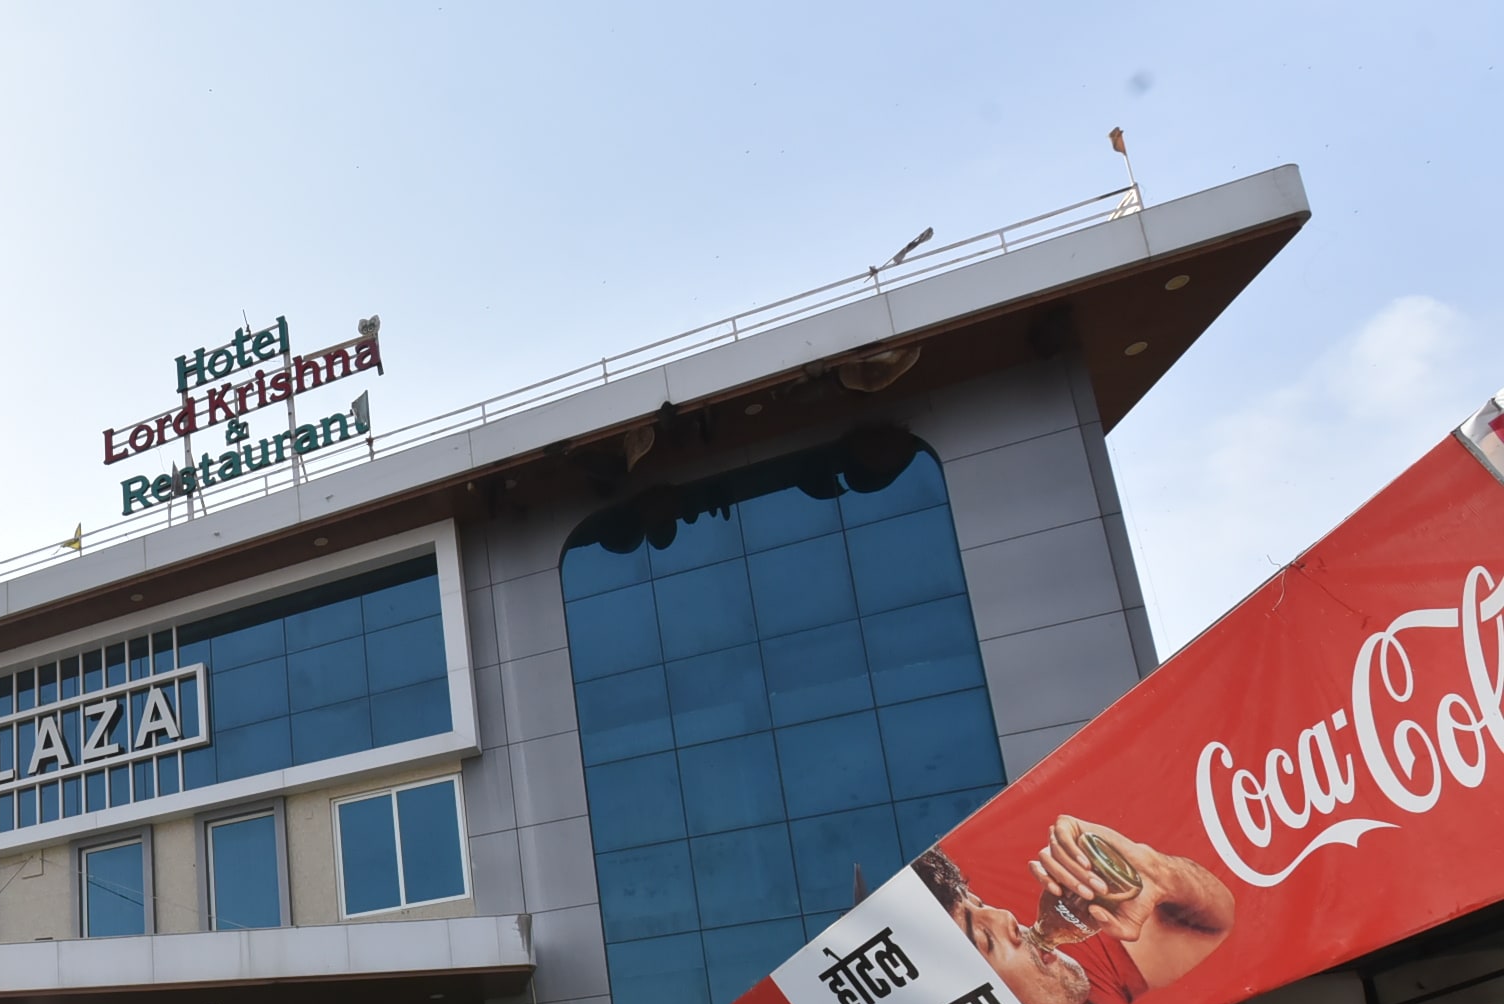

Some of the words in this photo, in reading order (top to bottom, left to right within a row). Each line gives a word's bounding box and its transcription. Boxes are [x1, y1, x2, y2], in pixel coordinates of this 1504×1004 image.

[103, 397, 196, 465] Lord
[207, 338, 382, 426] Krishna
[175, 315, 289, 393] Hotel
[225, 418, 249, 445] &
[1196, 565, 1504, 888] Coca-Col
